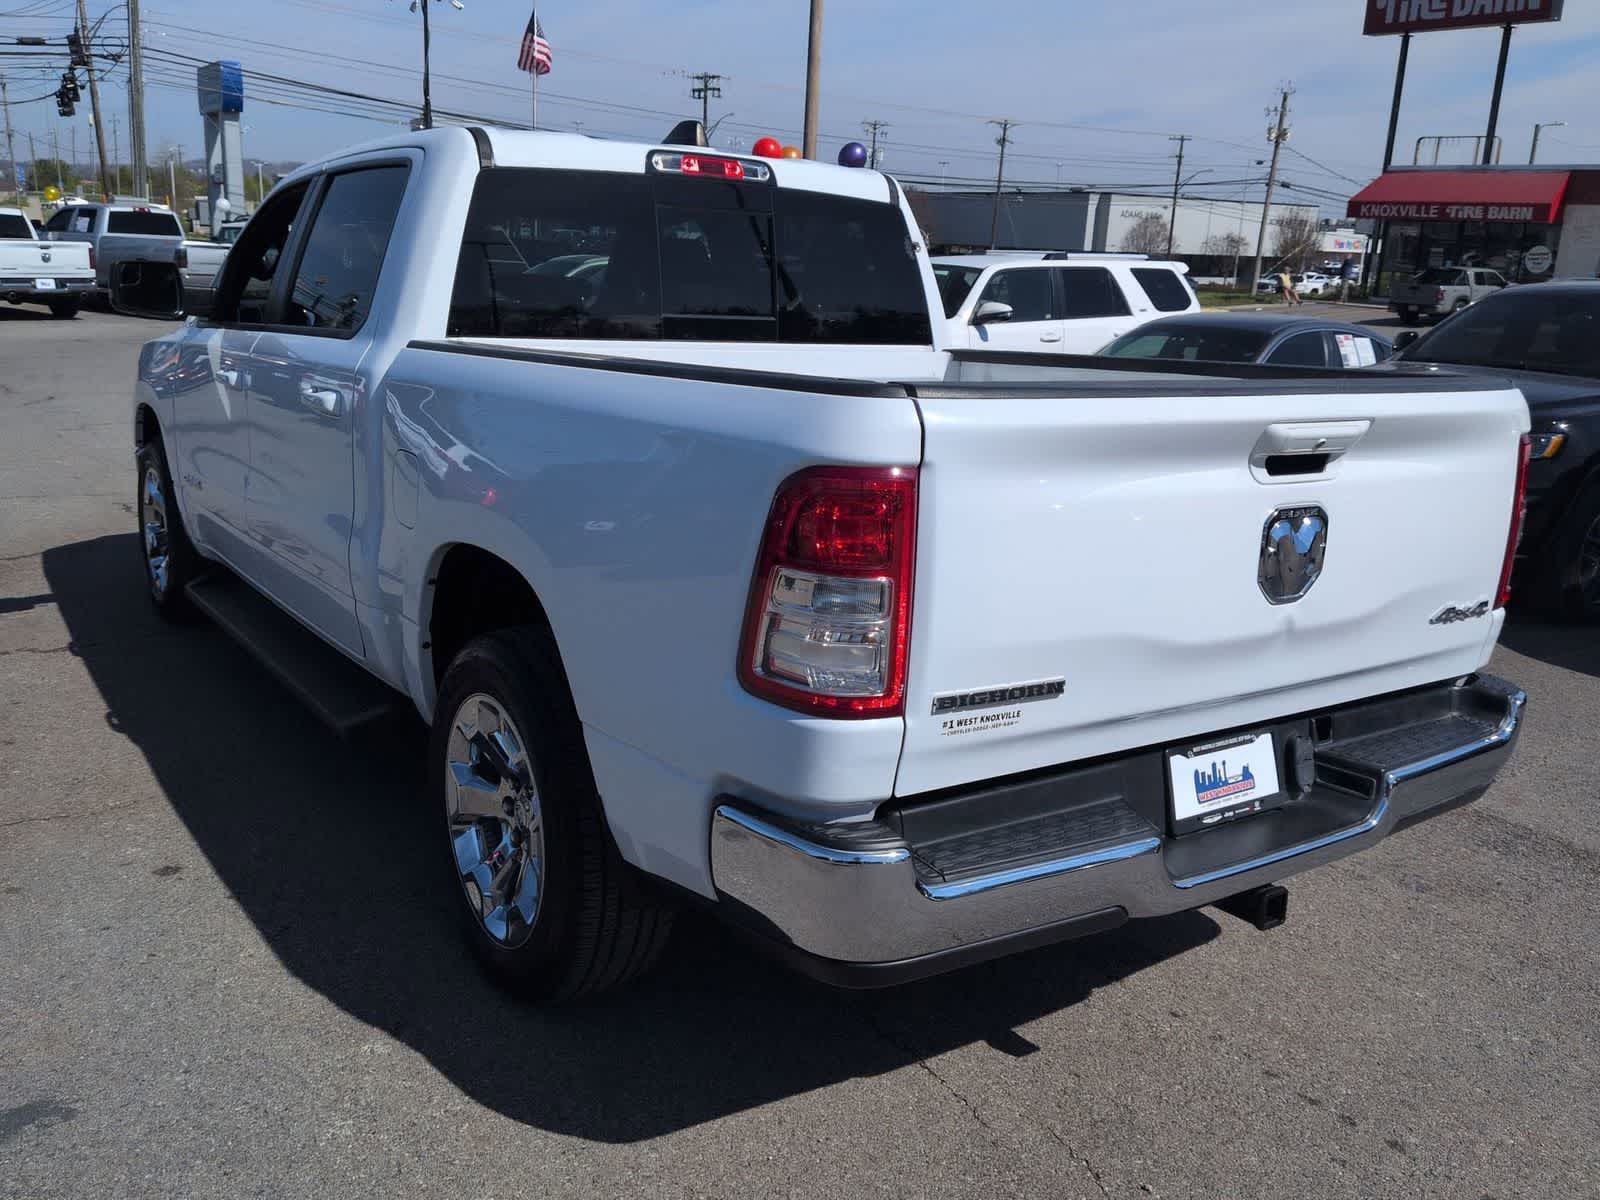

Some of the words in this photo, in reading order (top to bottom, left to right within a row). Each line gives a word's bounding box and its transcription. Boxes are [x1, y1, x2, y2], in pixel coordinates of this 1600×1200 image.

[1360, 203, 1440, 218] KNOXVILLE
[1487, 205, 1535, 220] BARN
[956, 716, 979, 728] WEST
[980, 710, 1022, 724] KNOXVILLE
